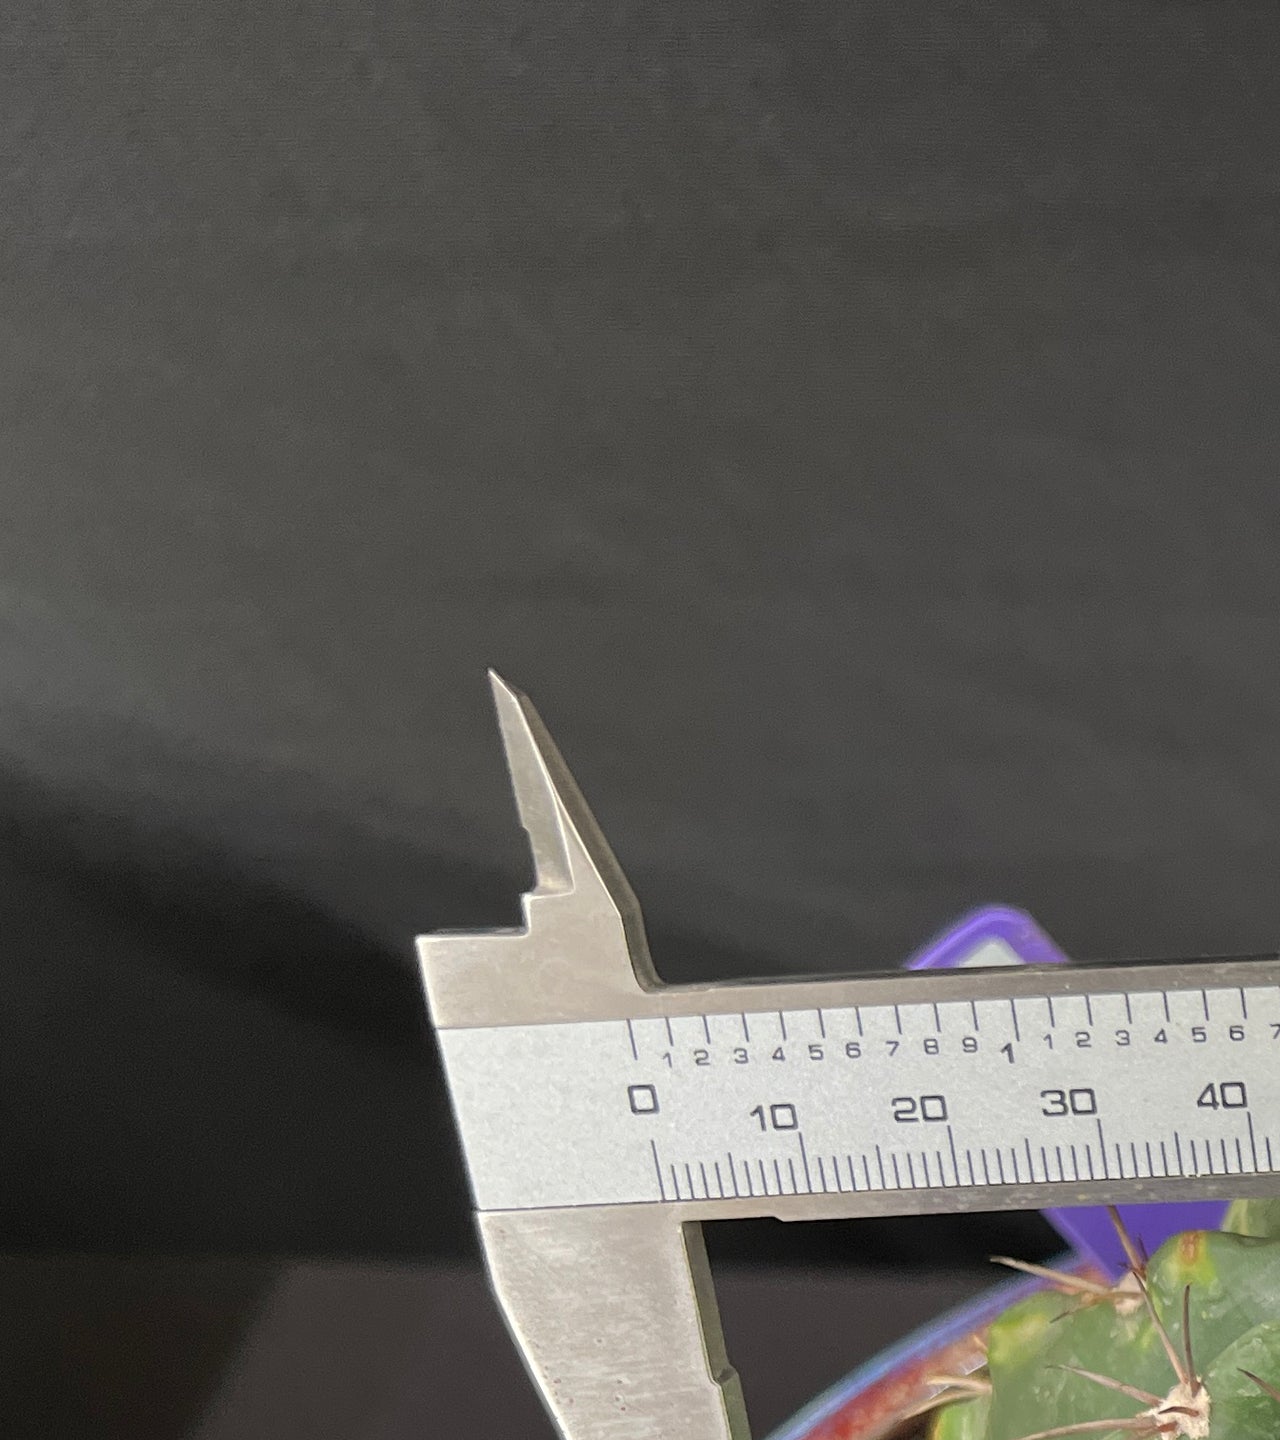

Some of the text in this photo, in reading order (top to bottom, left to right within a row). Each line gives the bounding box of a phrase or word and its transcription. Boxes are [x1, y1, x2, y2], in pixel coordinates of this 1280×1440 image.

[662, 1051, 673, 1069] 1
[693, 1048, 711, 1067] 2
[733, 1047, 749, 1065] 3
[771, 1046, 786, 1063] 4
[807, 1043, 825, 1061] 5
[844, 1041, 862, 1060] 6
[885, 1040, 901, 1057] 7
[923, 1037, 940, 1056] 8
[961, 1035, 979, 1054] 9
[999, 1042, 1016, 1065] 1
[1042, 1033, 1054, 1050] 1
[1074, 1031, 1092, 1049] 2
[1114, 1029, 1131, 1047] 3
[1153, 1027, 1169, 1045] 4
[1190, 1026, 1208, 1044] 5
[1228, 1024, 1246, 1042] 6
[626, 1083, 661, 1116] 0
[749, 1102, 799, 1132] 10
[890, 1094, 949, 1124] 20
[1039, 1087, 1098, 1118] 30
[1196, 1081, 1249, 1111] 40
